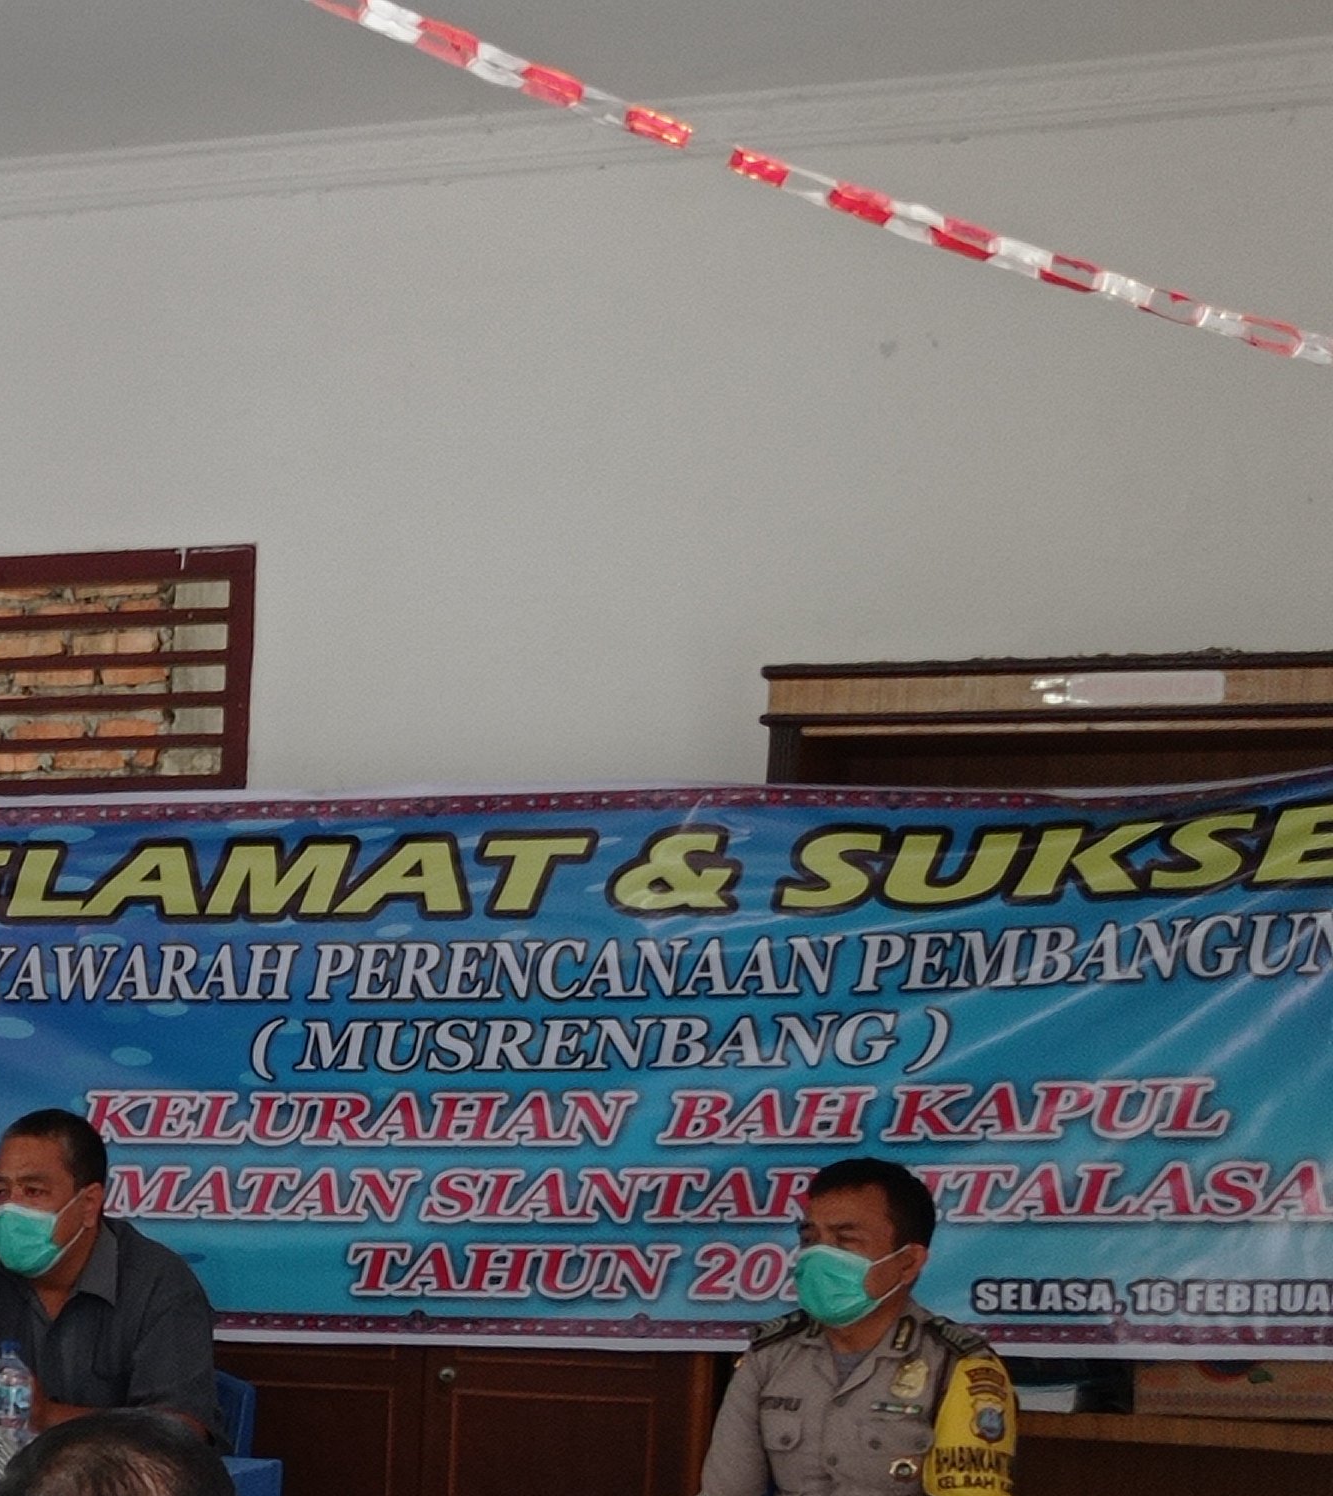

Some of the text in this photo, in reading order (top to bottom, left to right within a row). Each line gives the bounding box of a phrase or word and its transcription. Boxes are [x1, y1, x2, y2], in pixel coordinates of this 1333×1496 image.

[609, 825, 740, 914] &
[774, 800, 1333, 913] SUKSE
[306, 932, 848, 1002] PERENCANAAN
[293, 1009, 900, 1074] MUSRENBANG
[85, 1075, 1231, 1148] KELURAHAN BAH KAPUL
[347, 1241, 799, 1301] TAHUN 20
[972, 1278, 1127, 1317] SELASA,
[1129, 1278, 1181, 1316] 16
